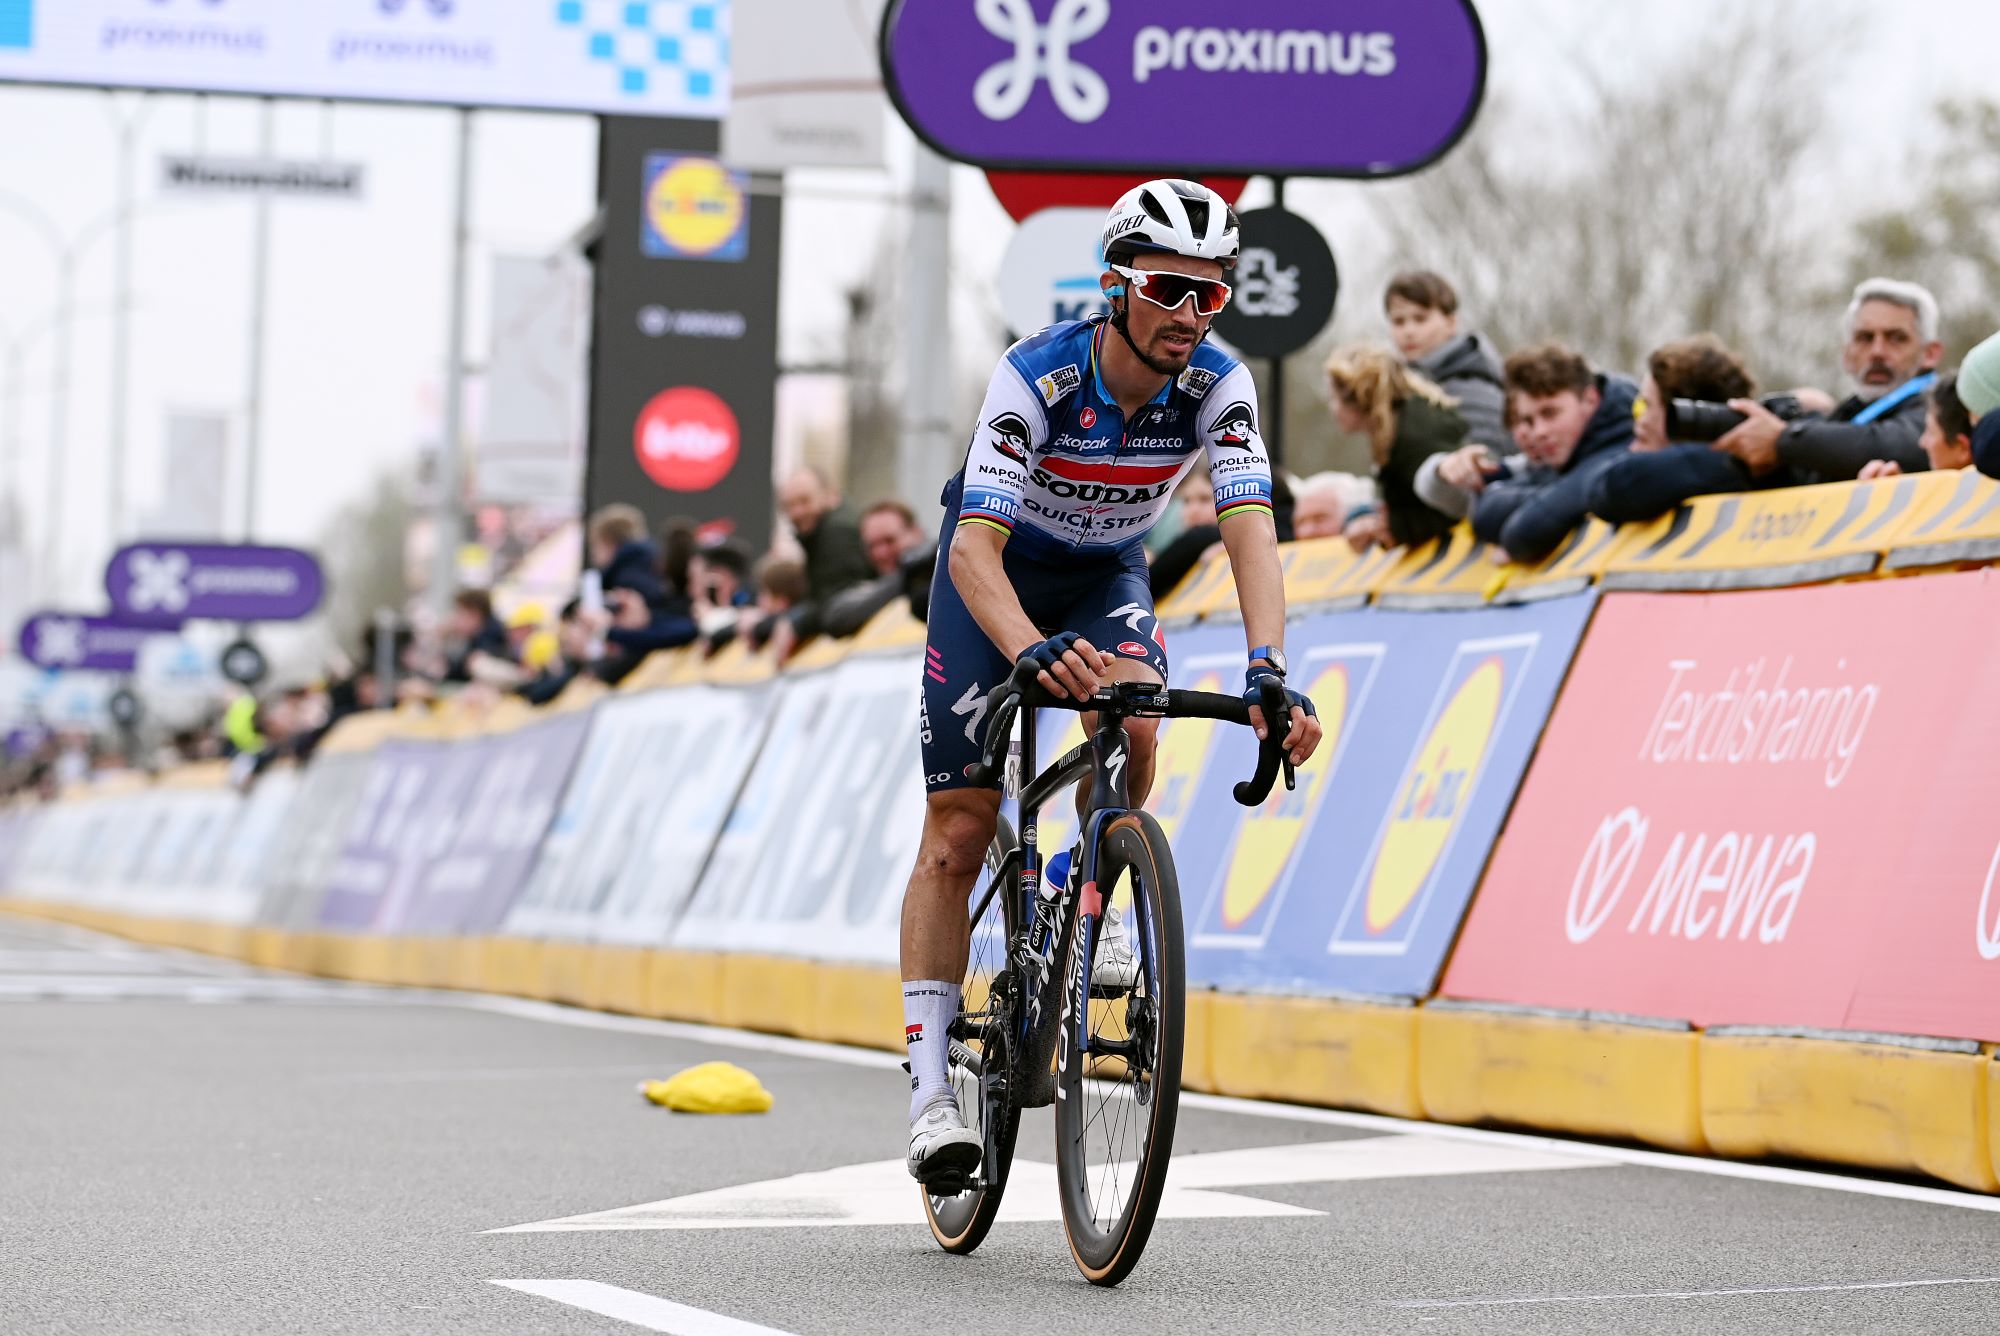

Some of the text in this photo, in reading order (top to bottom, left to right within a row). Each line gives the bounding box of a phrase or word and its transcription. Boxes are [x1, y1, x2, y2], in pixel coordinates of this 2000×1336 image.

[1132, 24, 1397, 84] proximus
[1051, 366, 1077, 383] SAFETY
[1127, 435, 1183, 449] latexco
[1219, 465, 1251, 475] SPORTS
[1029, 468, 1171, 505] SOUDAL
[980, 495, 1020, 518] JANO
[1637, 655, 1882, 788] Textilsharing
